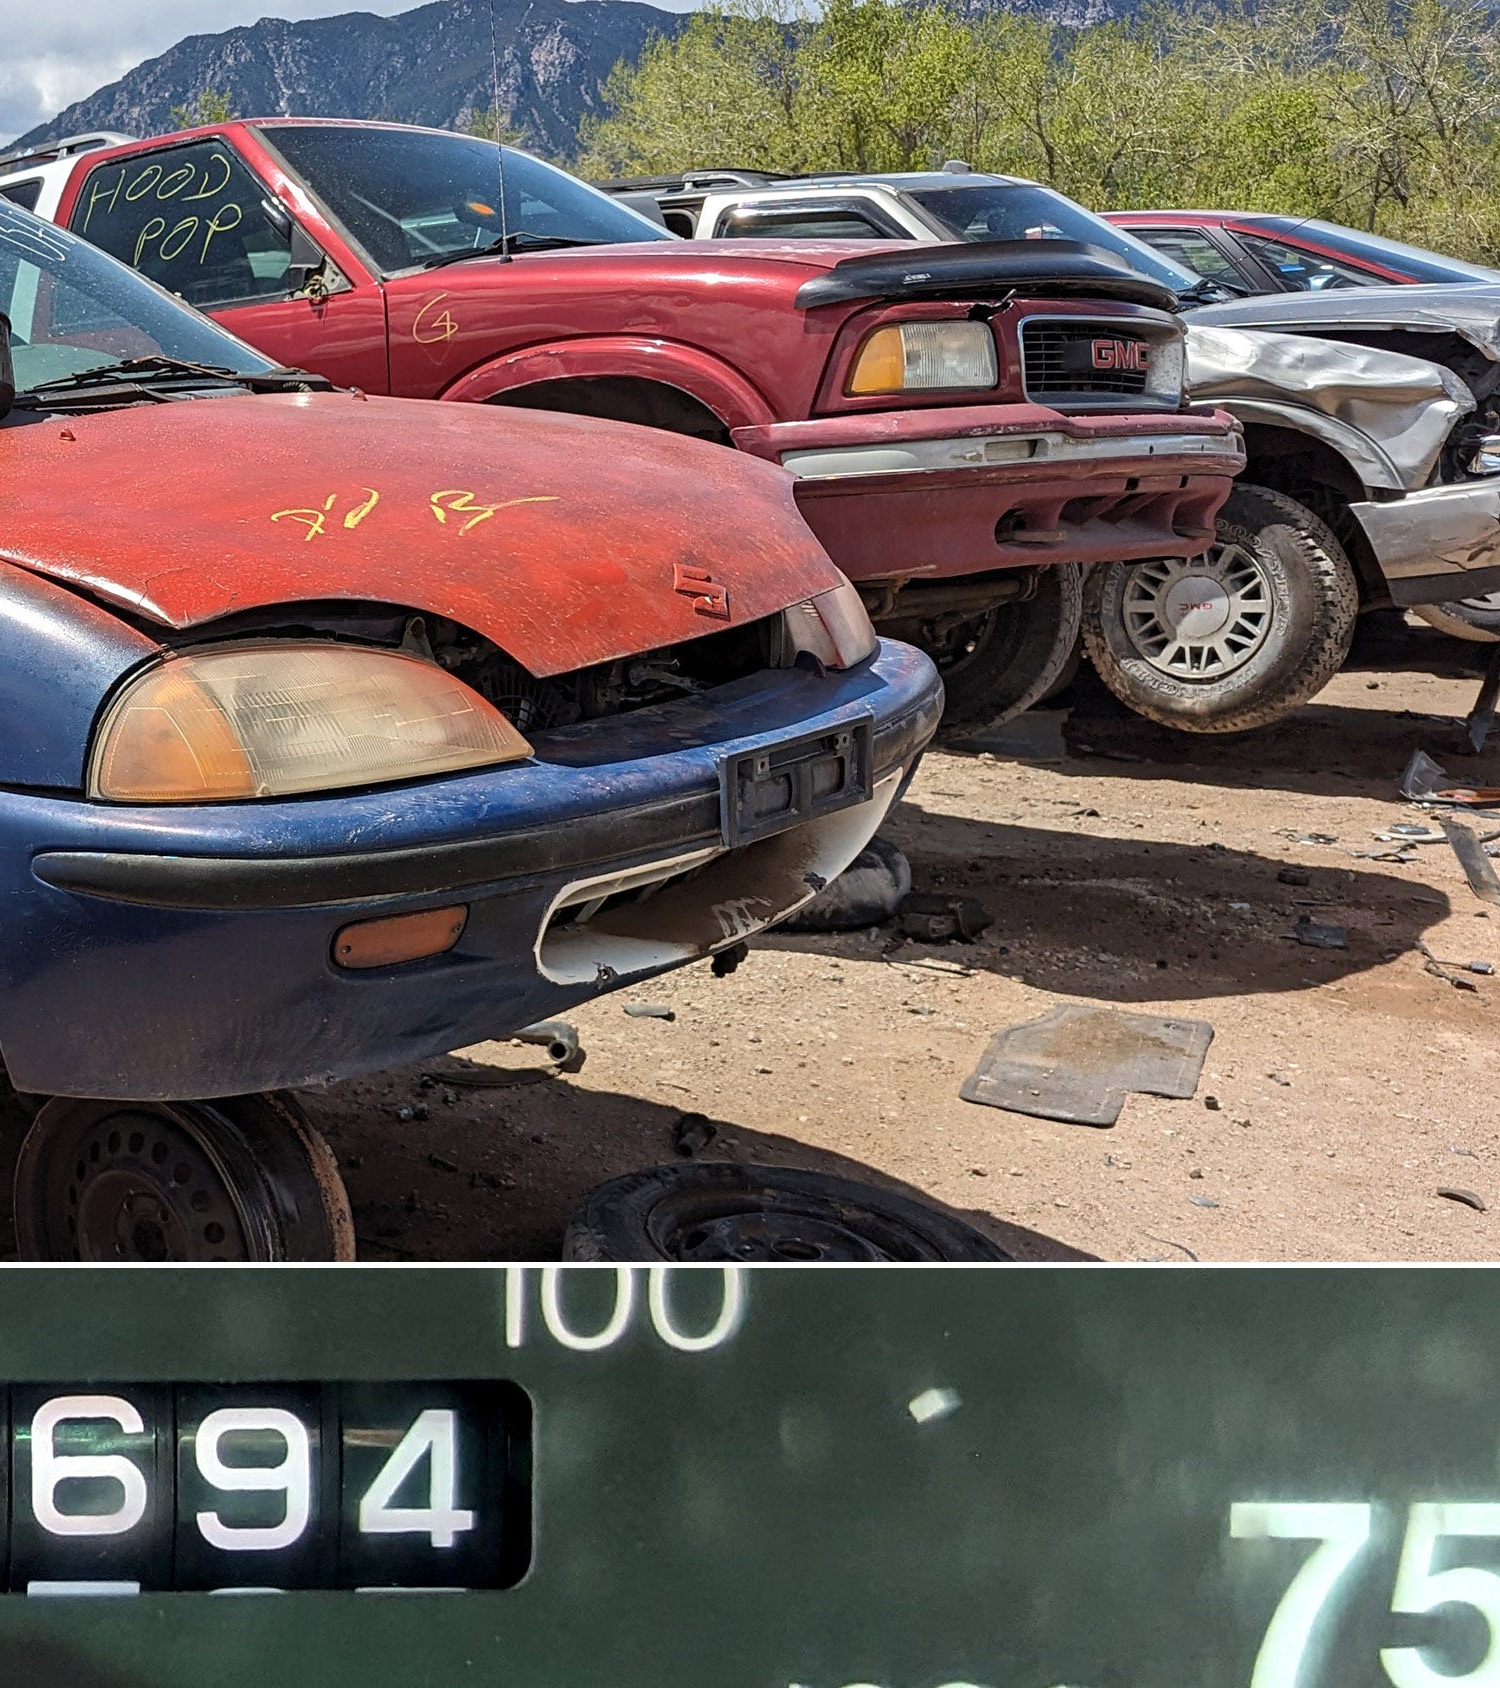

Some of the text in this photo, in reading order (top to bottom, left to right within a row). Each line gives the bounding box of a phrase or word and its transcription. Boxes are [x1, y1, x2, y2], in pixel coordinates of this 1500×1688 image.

[84, 153, 231, 233] HOOD
[133, 203, 243, 266] POP
[1091, 338, 1152, 371] GMC
[1178, 601, 1214, 612] GMC
[506, 1266, 743, 1351] 100
[1228, 1493, 1500, 1688] 75
